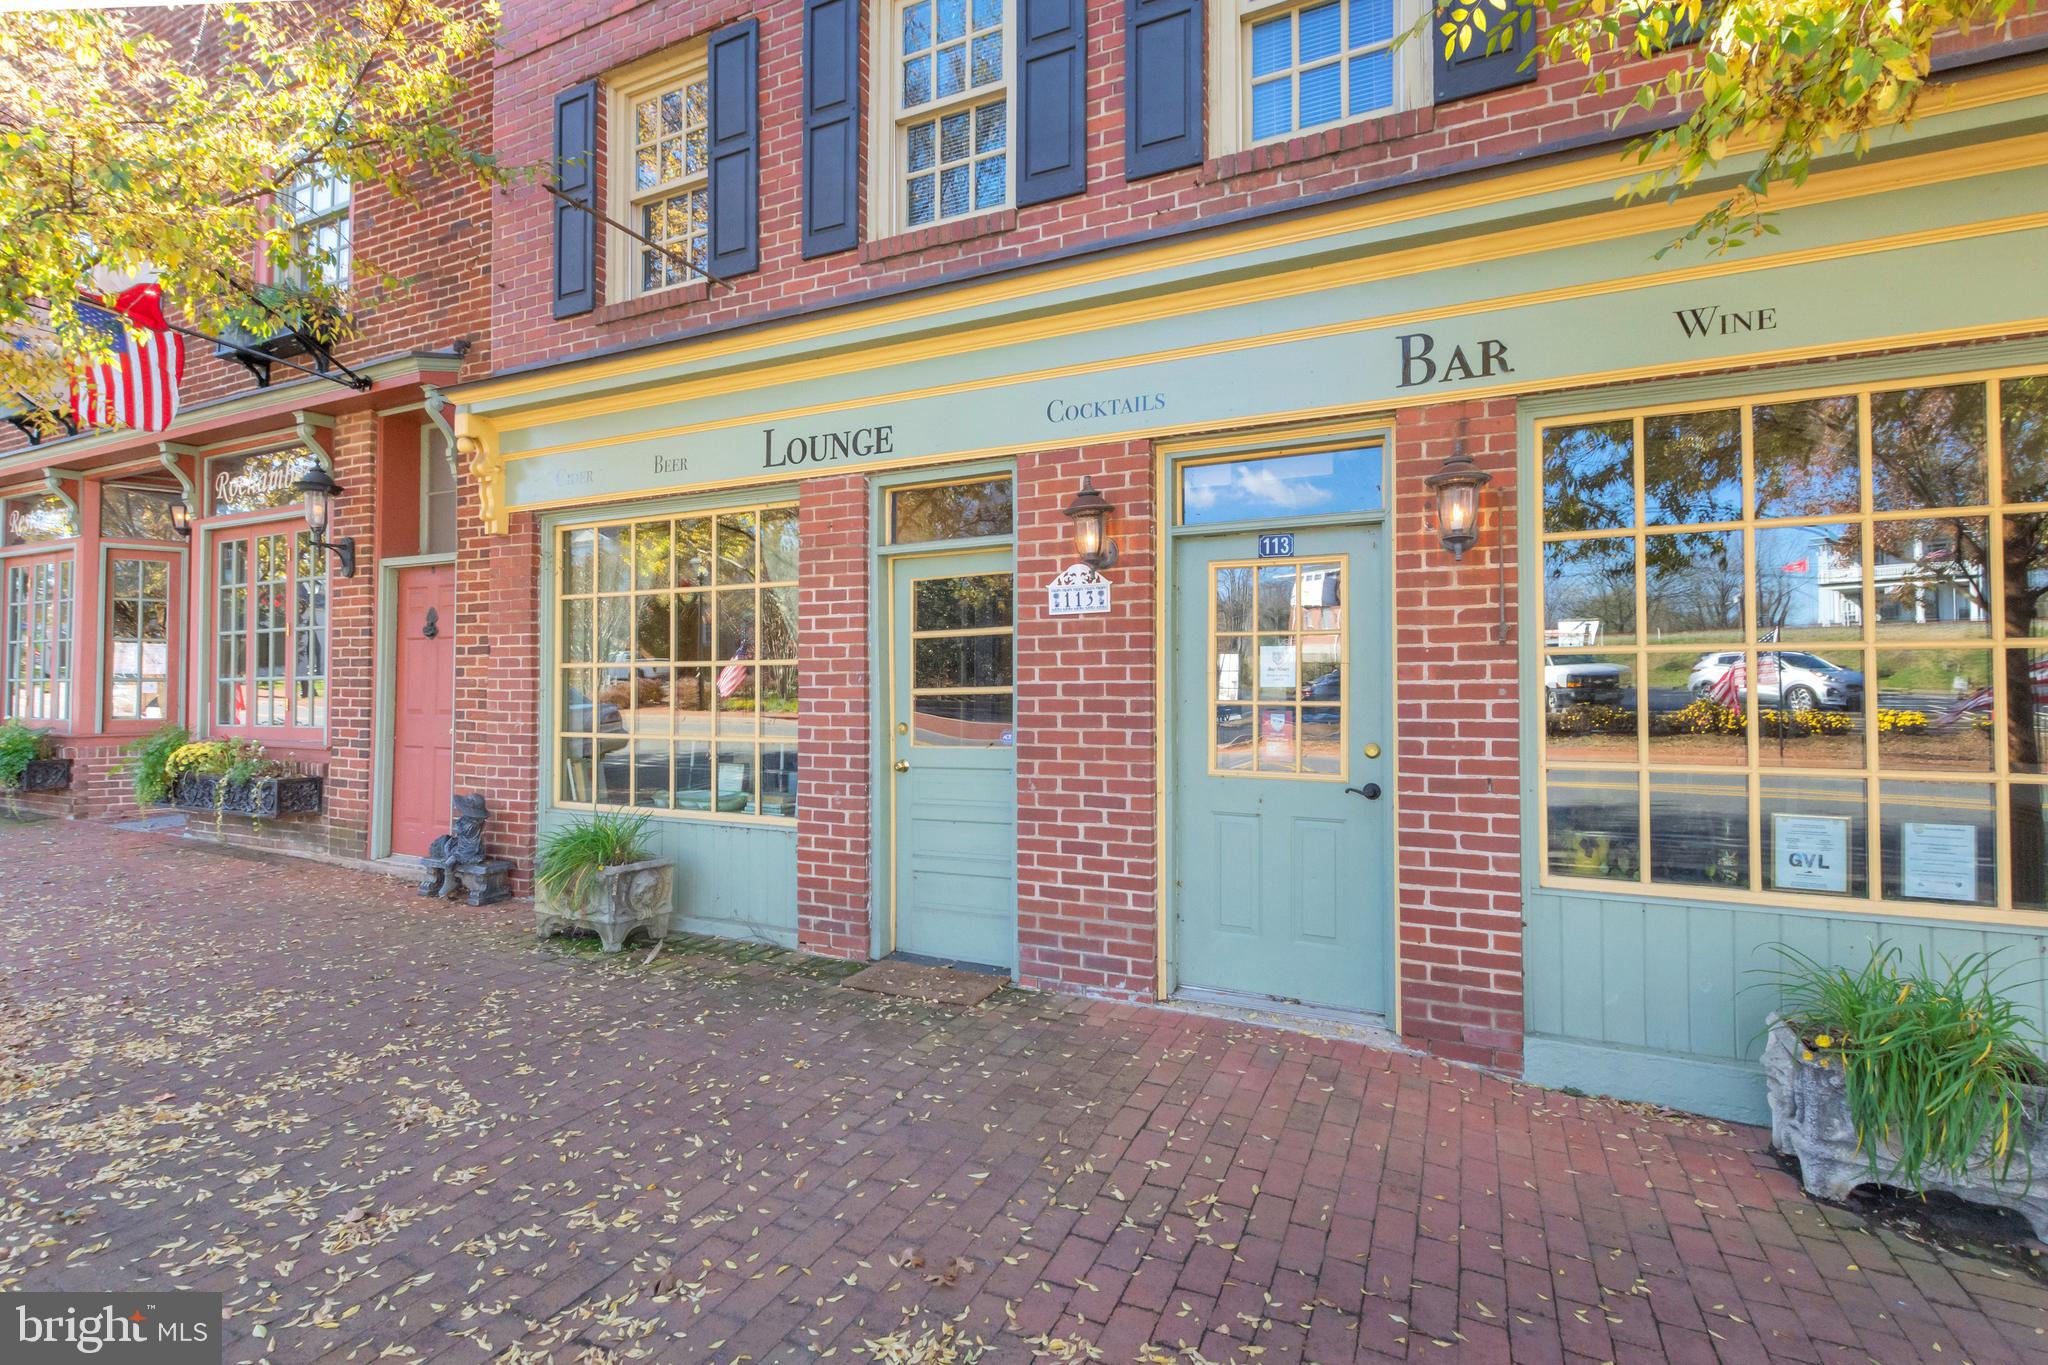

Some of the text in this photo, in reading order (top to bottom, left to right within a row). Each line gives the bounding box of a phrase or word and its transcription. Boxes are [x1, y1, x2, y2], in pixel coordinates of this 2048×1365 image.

[1672, 305, 1777, 339] WINE
[1395, 333, 1515, 388] BAR
[1046, 392, 1166, 423] COCKTAILS
[762, 425, 893, 468] LOUNGE
[654, 454, 688, 474] BEER
[1263, 537, 1290, 554] 113
[1064, 591, 1094, 608] 113
[1788, 852, 1830, 870] GVL
